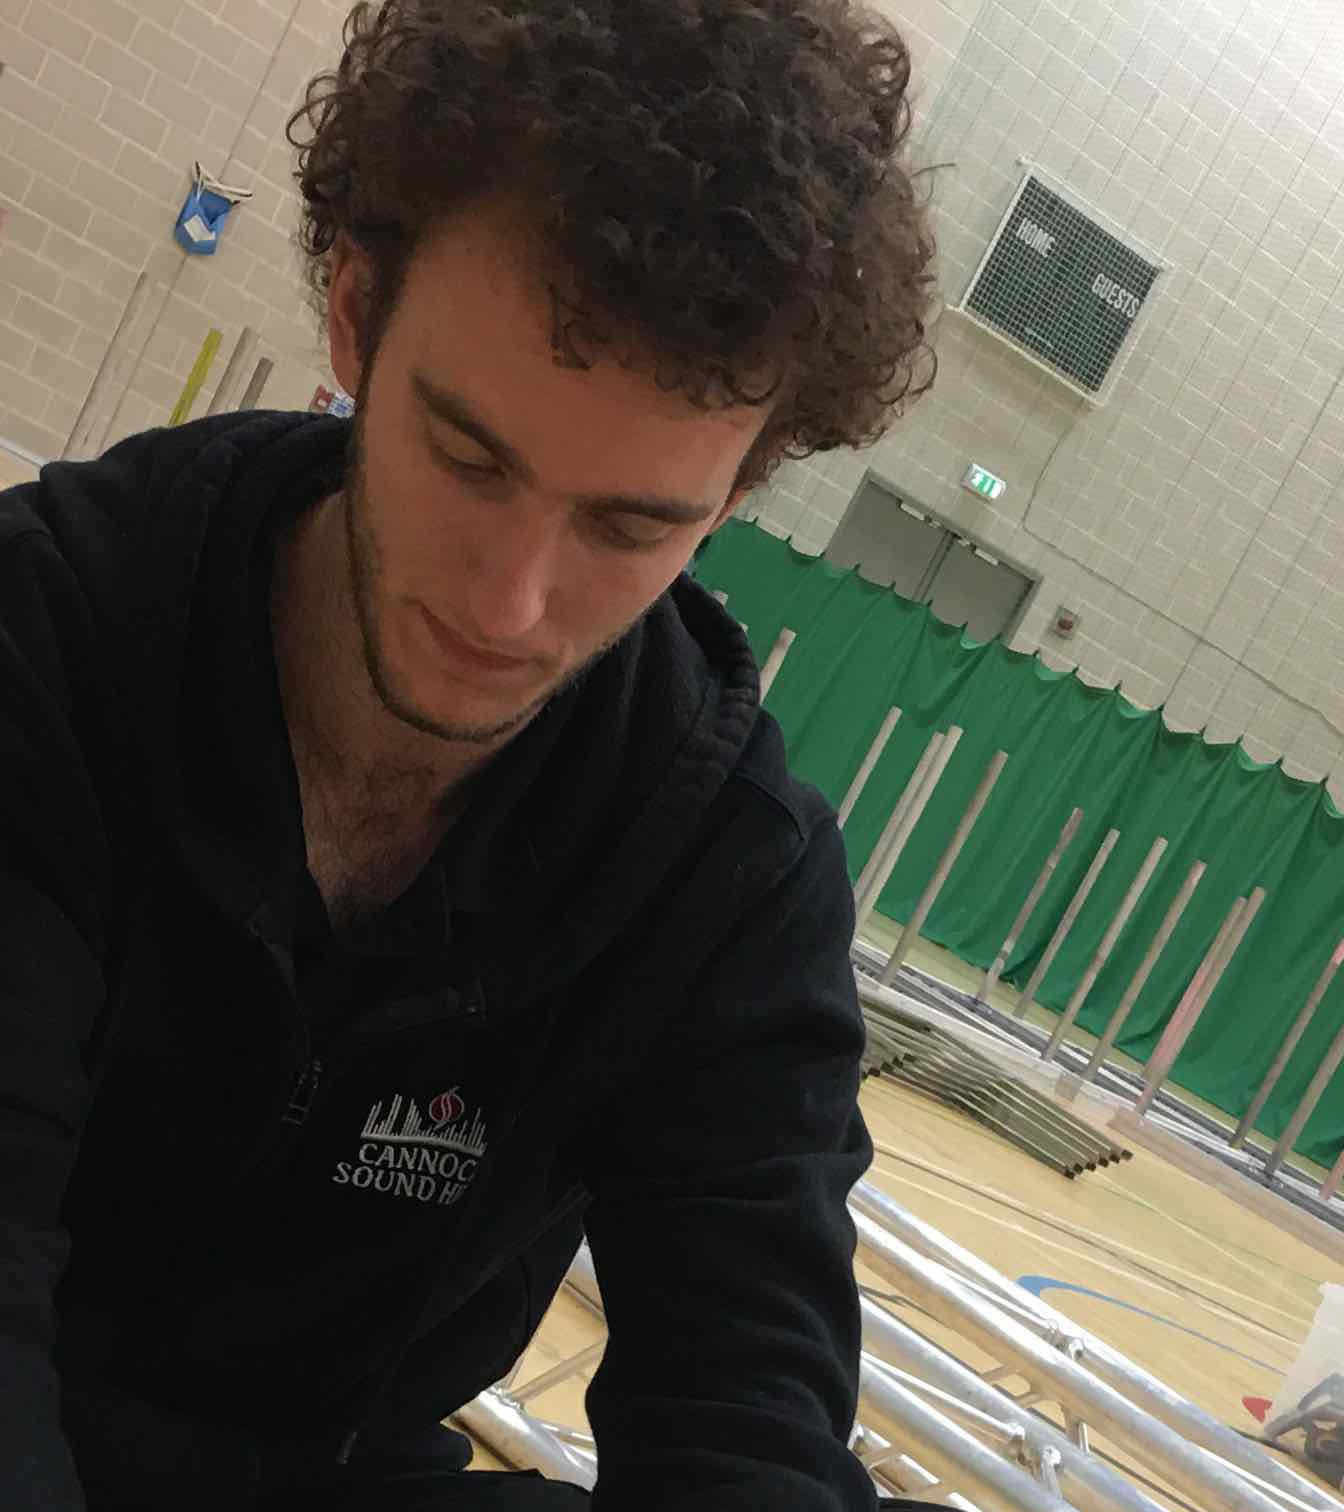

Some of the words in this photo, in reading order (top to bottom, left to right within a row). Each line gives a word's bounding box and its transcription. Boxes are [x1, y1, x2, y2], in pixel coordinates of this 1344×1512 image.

[1015, 217, 1056, 258] HOME
[1091, 273, 1140, 318] GUESTS
[332, 1161, 436, 1201] SOUND
[358, 1143, 477, 1182] CANNOC
